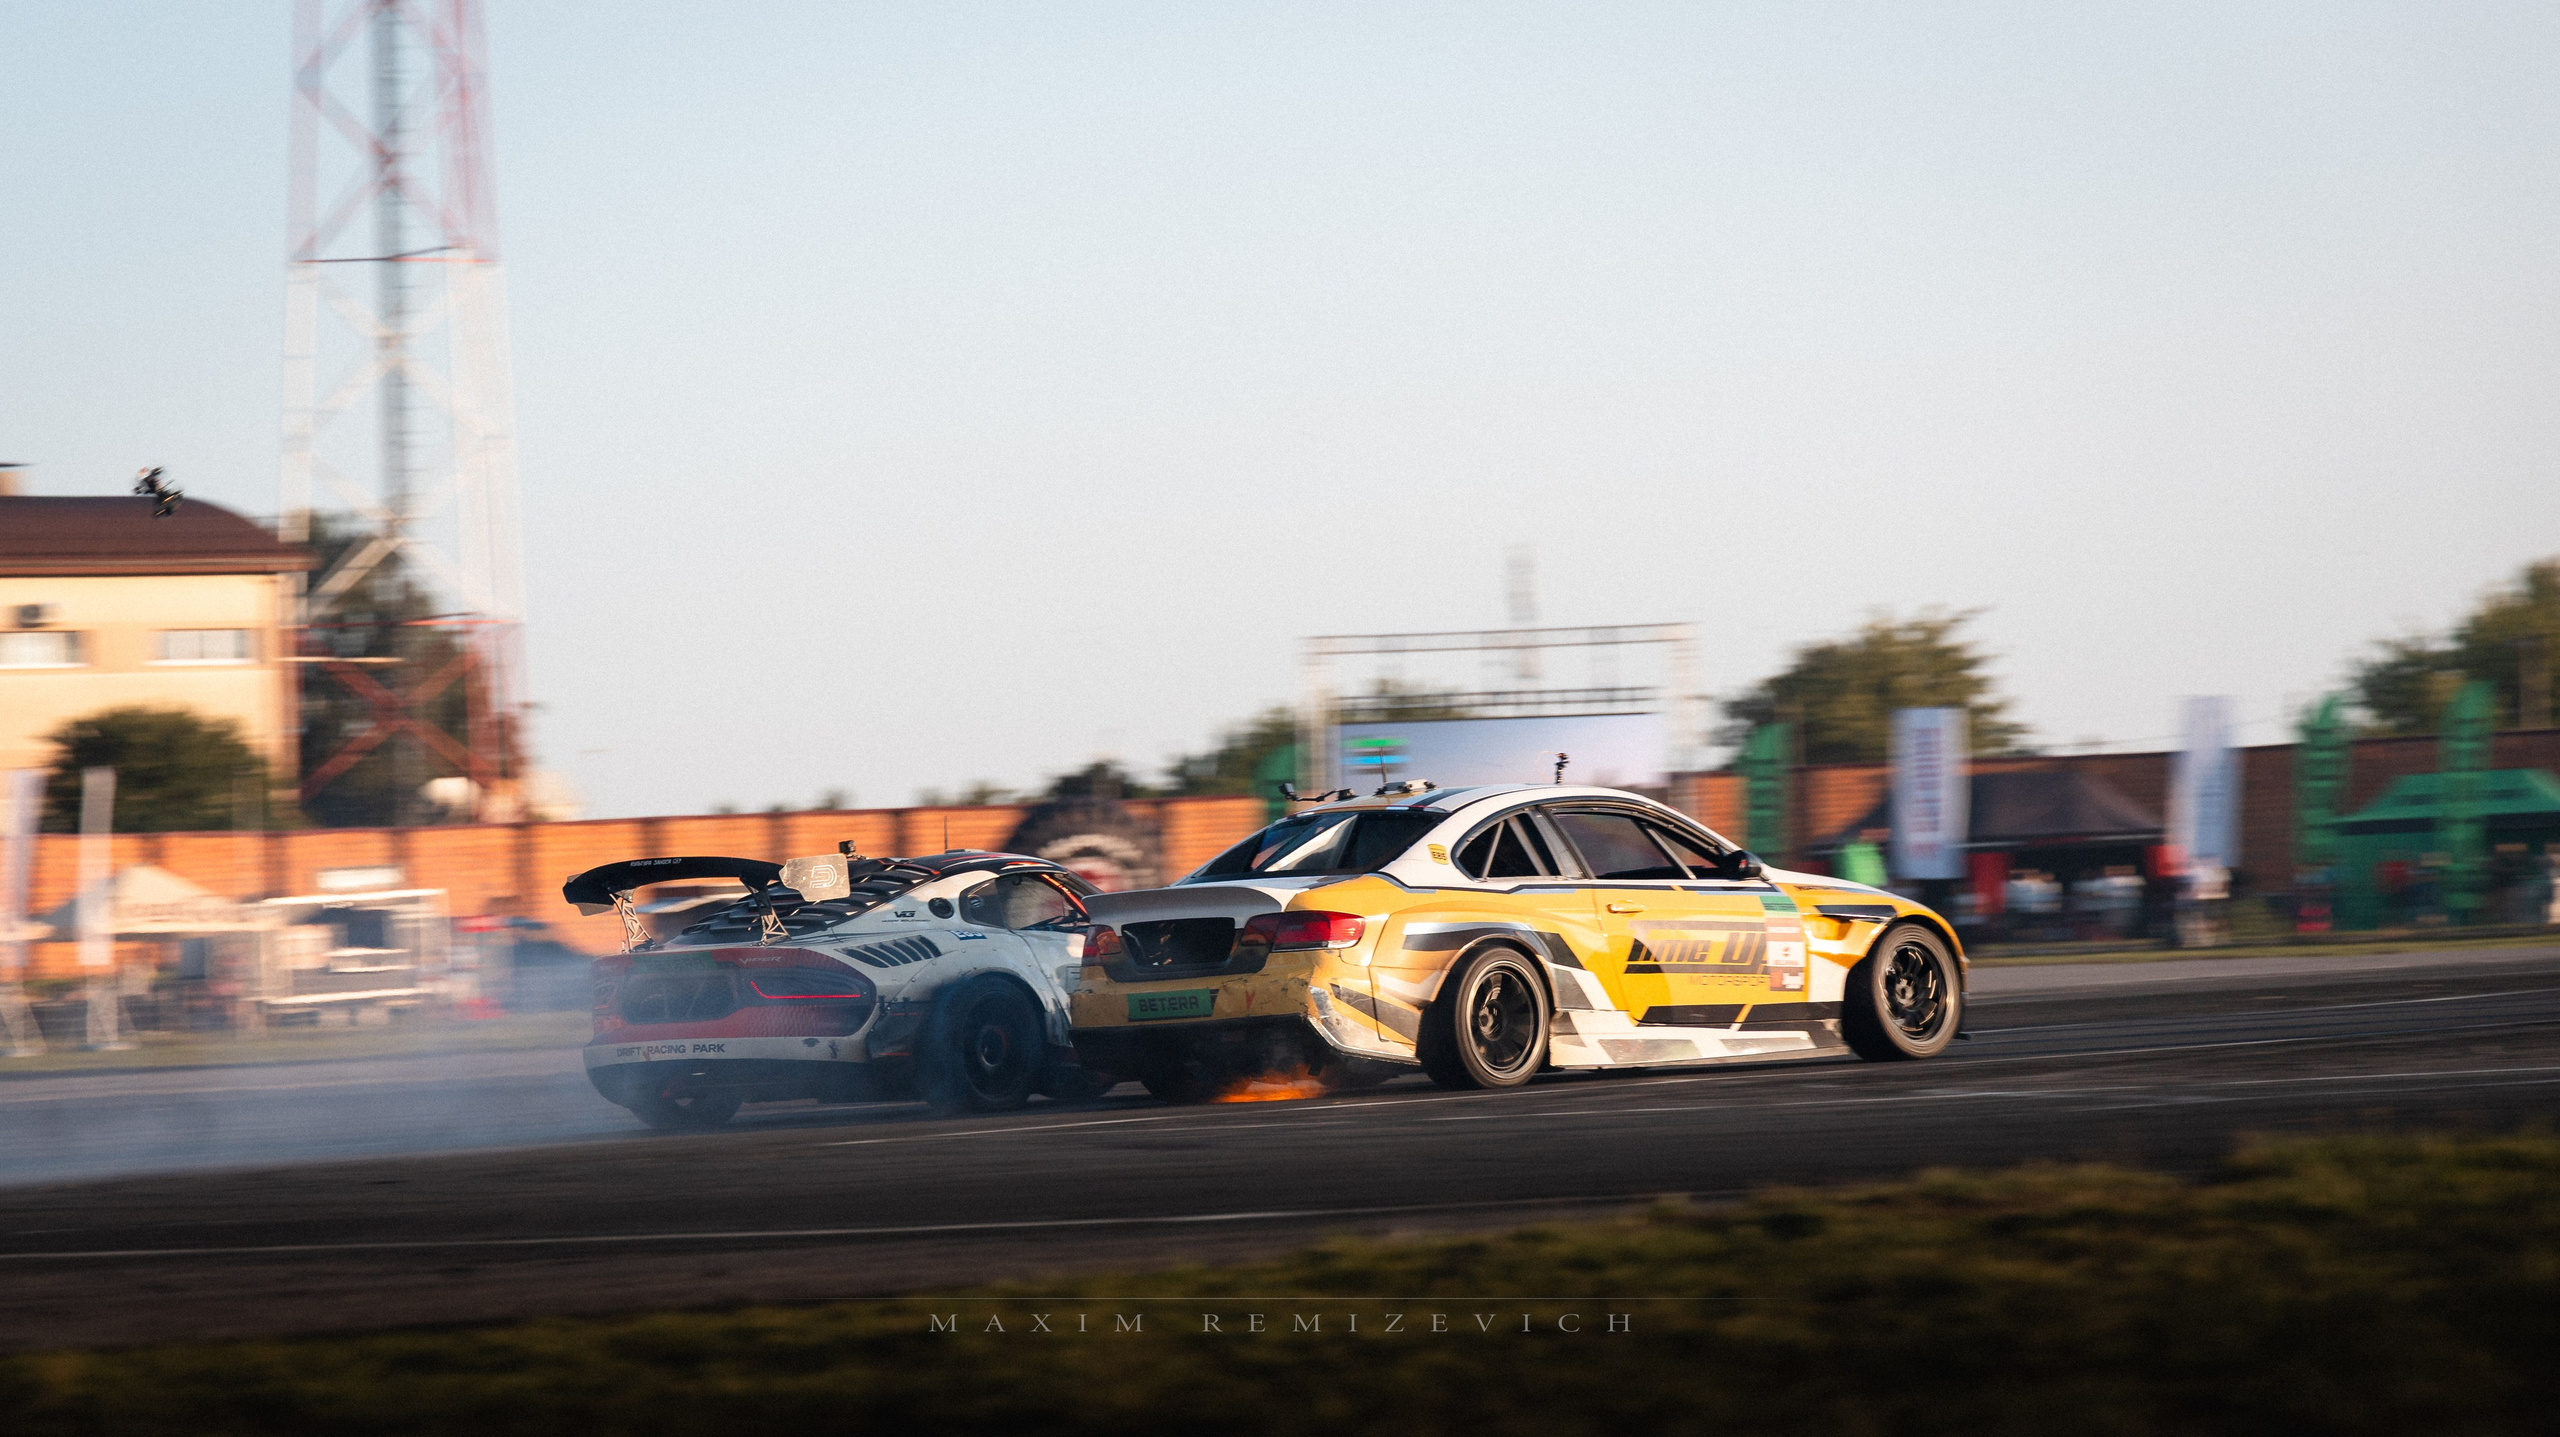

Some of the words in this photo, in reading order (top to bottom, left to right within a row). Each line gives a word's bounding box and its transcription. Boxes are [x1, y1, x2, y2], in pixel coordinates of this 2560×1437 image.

[739, 956, 782, 965] VIPER
[1688, 975, 1771, 986] MOTORSPOR
[617, 1047, 641, 1058] DRIFT
[647, 1045, 686, 1055] RACING
[693, 1043, 725, 1053] PARK
